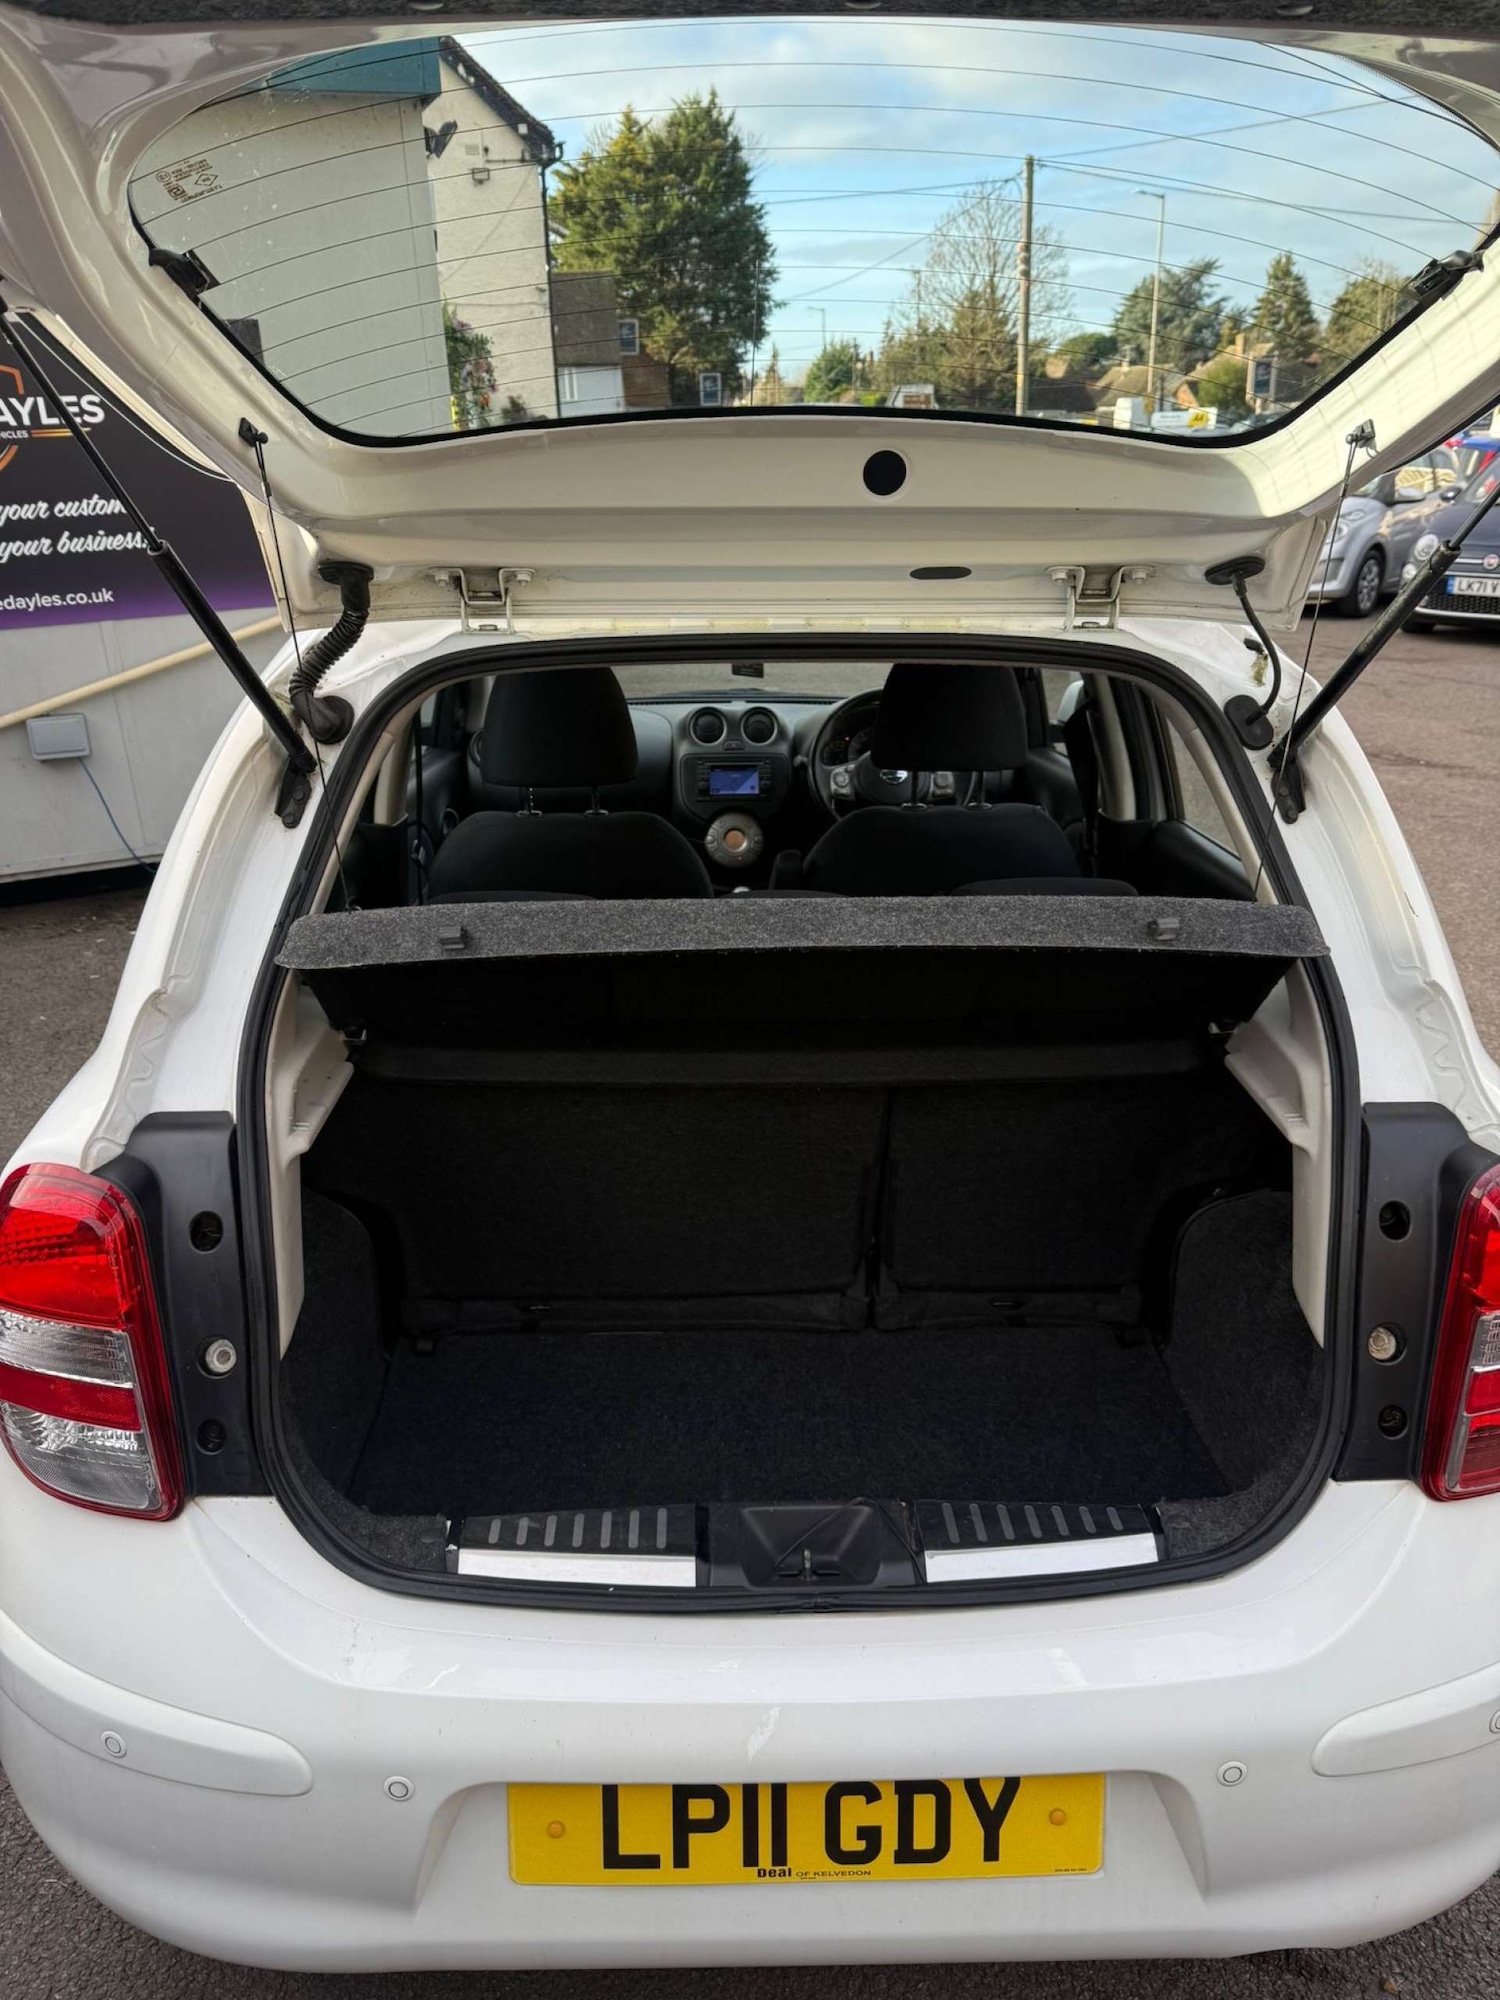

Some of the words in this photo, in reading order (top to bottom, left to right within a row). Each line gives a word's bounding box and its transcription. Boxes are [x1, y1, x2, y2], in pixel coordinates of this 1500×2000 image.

[0, 537, 52, 564] your
[602, 1784, 788, 1870] LP11
[824, 1777, 1021, 1865] GDY
[757, 1867, 792, 1878] Deal
